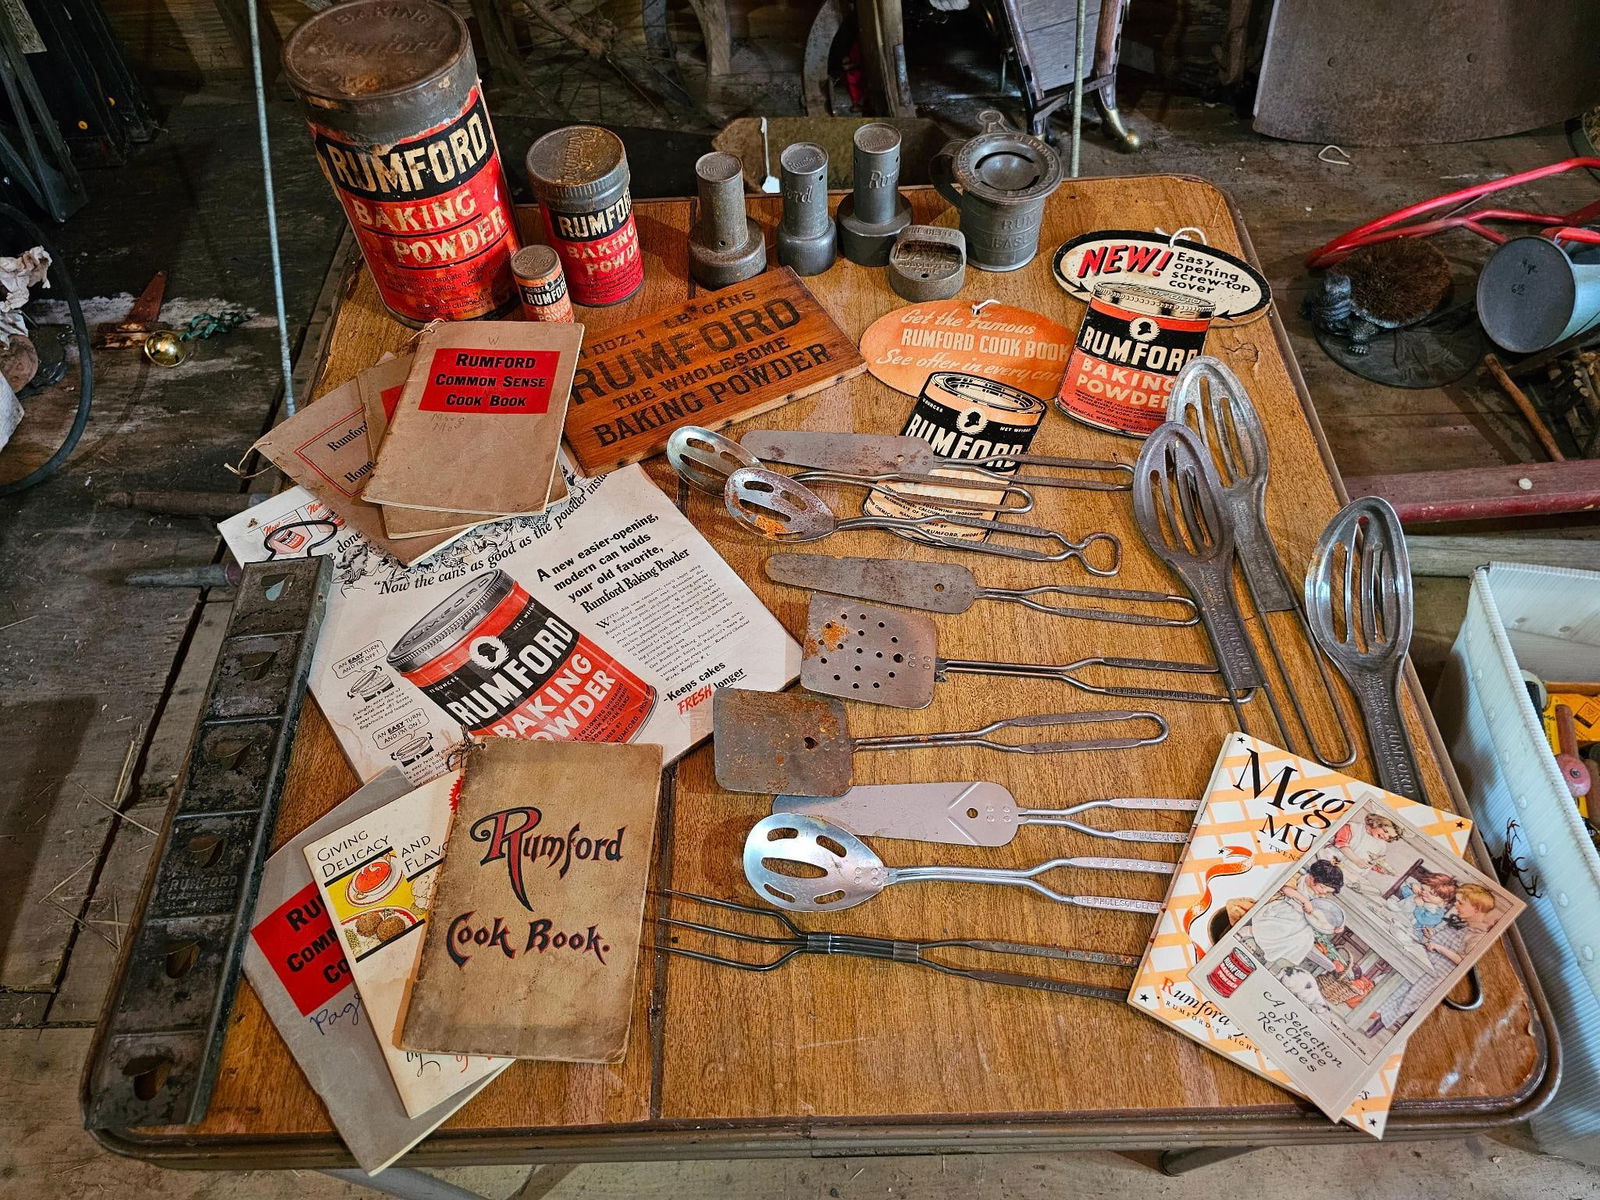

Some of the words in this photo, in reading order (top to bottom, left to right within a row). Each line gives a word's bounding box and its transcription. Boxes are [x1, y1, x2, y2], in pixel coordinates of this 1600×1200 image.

[326, 111, 488, 195] RUMFORD
[350, 188, 477, 234] BAKING
[557, 190, 632, 238] RUMFOR
[392, 208, 508, 267] POWDER
[567, 222, 636, 259] BAKING
[586, 236, 638, 276] POWD
[1176, 251, 1215, 268] Easy
[1076, 244, 1174, 278] NEW!
[1171, 270, 1250, 294] screw-top
[1173, 262, 1239, 283] opening
[526, 280, 567, 305] RUMFOR
[699, 290, 757, 315] CANS
[1169, 279, 1215, 295] cover
[901, 308, 933, 325] Get
[934, 308, 965, 328] the
[964, 313, 1037, 335] famous
[455, 353, 537, 369] RUMFORD
[570, 298, 801, 405] RUMFORD
[875, 348, 914, 367] See
[915, 351, 961, 370] offer
[961, 357, 982, 374] in
[983, 365, 1031, 383] every
[900, 328, 975, 352] RUMFORD
[978, 334, 1022, 358] COOK
[1023, 341, 1070, 363] BOOK
[435, 373, 497, 387] COMMON
[502, 376, 547, 388] SENSE
[592, 391, 702, 448] BAKING
[705, 342, 834, 405] POWDER
[612, 386, 657, 410] THE
[657, 336, 791, 393] WHOLESOME
[446, 394, 483, 406] COOK
[489, 395, 528, 407] BOOK
[343, 460, 374, 484] Home
[336, 531, 363, 554] done
[415, 574, 434, 587] the
[470, 560, 484, 571] as
[488, 541, 517, 569] good
[519, 535, 532, 547] as
[533, 522, 553, 540] the
[554, 493, 587, 529] powder
[536, 568, 551, 583] A
[551, 557, 575, 575] new
[577, 513, 659, 560] easier-opening,
[554, 563, 597, 592] modern
[599, 551, 620, 566] can
[619, 533, 651, 554] holds
[568, 582, 593, 604] your
[596, 568, 616, 585] old
[616, 546, 664, 574] favorite,
[580, 582, 627, 614] Rumford
[622, 565, 660, 590] Baking
[654, 548, 691, 572] Powder
[347, 652, 364, 664] EASY
[446, 616, 573, 727] RUMFORD
[698, 660, 727, 681] cakes
[491, 653, 592, 740] BAKING
[529, 669, 617, 742] OWDER
[676, 683, 713, 715] FRESH
[713, 667, 745, 689] longer
[387, 722, 405, 734] EASY
[1232, 747, 1356, 830] Mag
[316, 830, 370, 863] GIVING
[321, 835, 391, 879] DELICACY
[400, 834, 432, 858] AND
[469, 806, 628, 912] Rumford
[286, 927, 339, 973] COMM
[446, 909, 517, 971] Cook
[523, 918, 611, 966] Book.
[322, 957, 351, 984] CO
[1165, 1000, 1221, 1034] RUMFORD'S
[1227, 1034, 1260, 1054] RIGHT
[1257, 1011, 1317, 1073] Recipes
[1267, 1011, 1288, 1025] of
[1284, 1027, 1327, 1067] Choice
[1284, 1011, 1343, 1069] Selection
